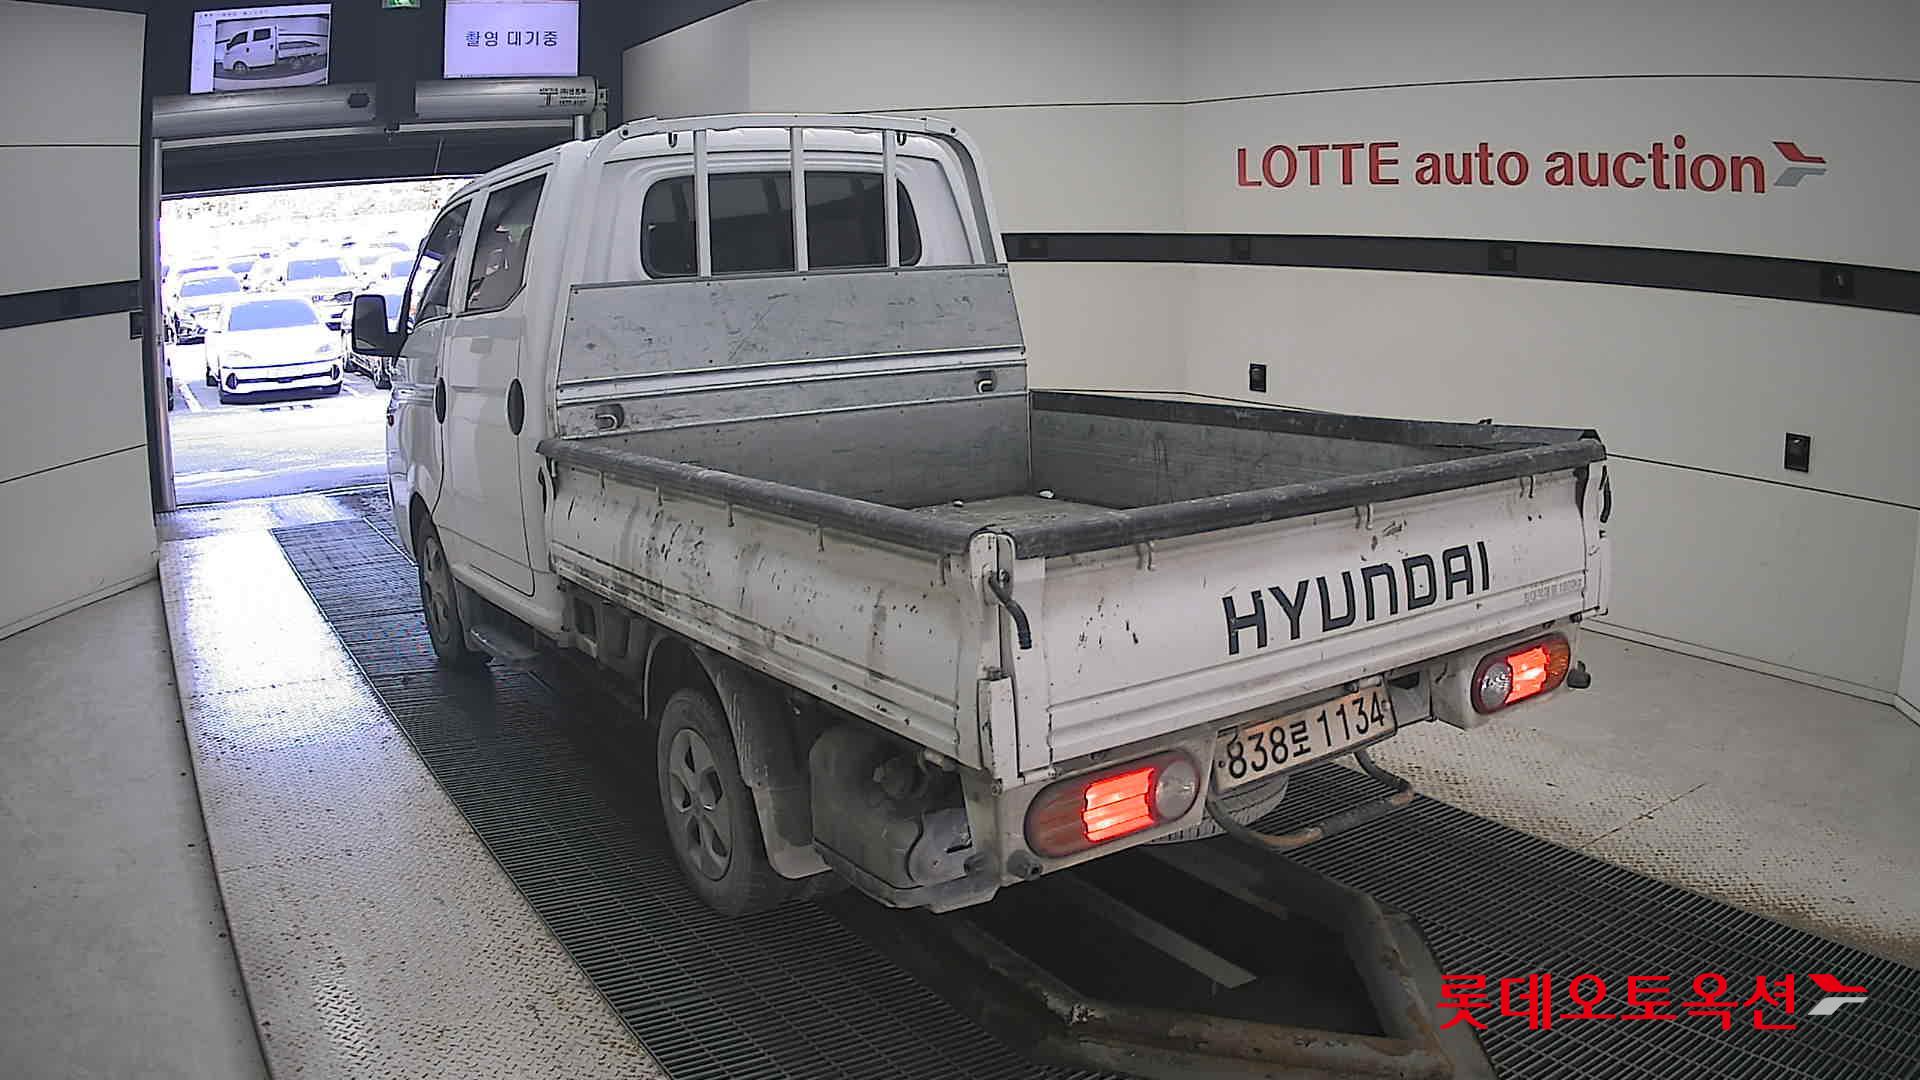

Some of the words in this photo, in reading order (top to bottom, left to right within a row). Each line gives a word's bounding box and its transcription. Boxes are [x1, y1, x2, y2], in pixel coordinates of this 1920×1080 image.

[464, 31, 498, 47] 촬영
[507, 31, 559, 47] 대기중
[1237, 142, 1399, 188] LOTTE
[1415, 142, 1529, 186] auto
[1545, 134, 1765, 194] auction
[1222, 541, 1490, 656] HYUNDAI
